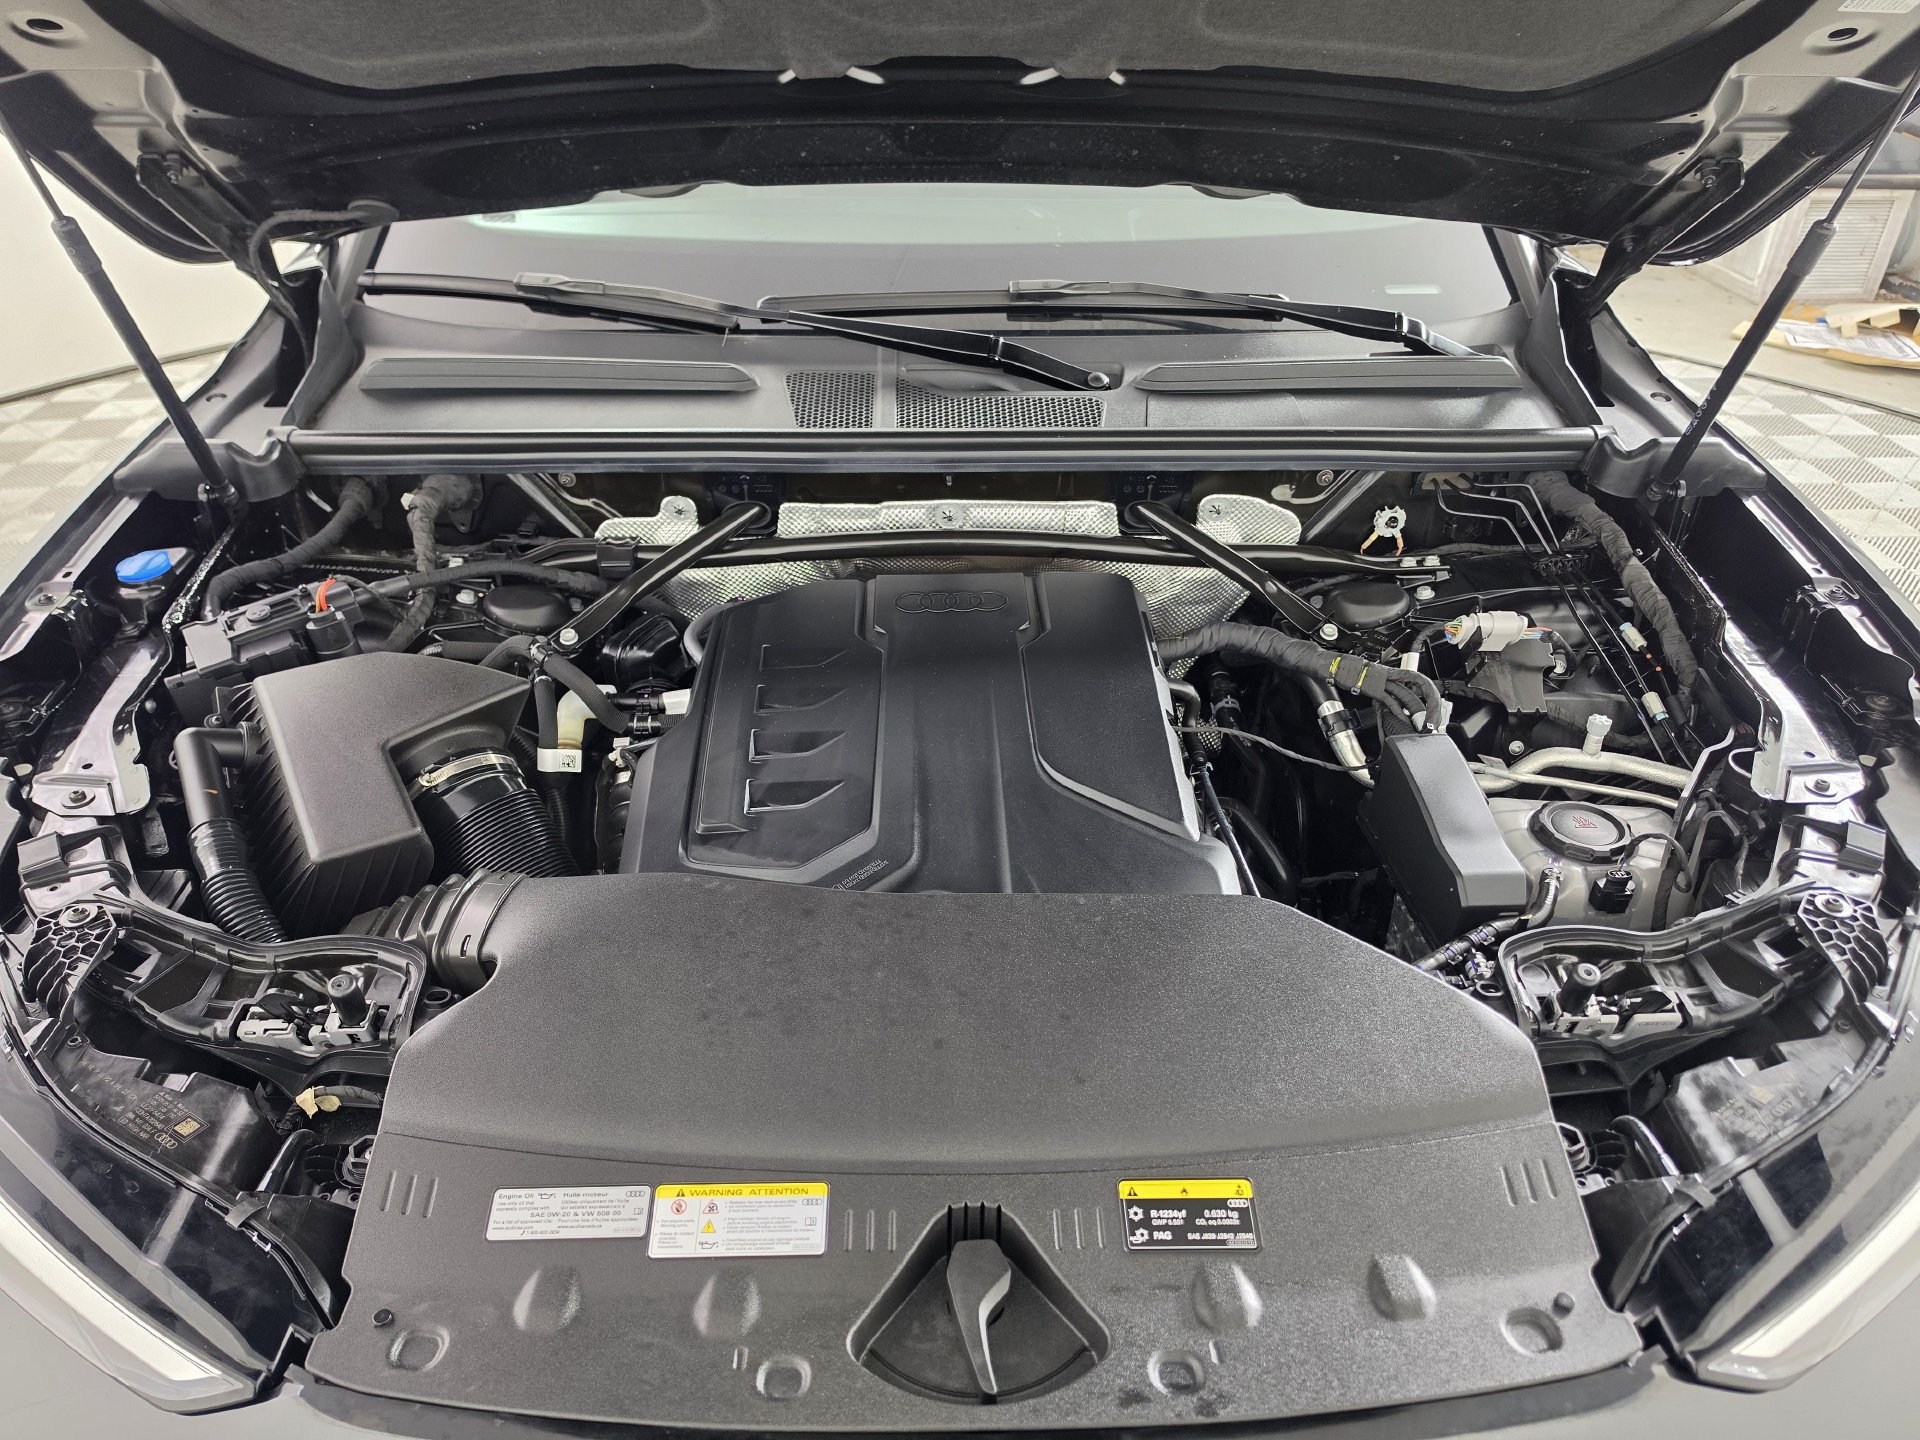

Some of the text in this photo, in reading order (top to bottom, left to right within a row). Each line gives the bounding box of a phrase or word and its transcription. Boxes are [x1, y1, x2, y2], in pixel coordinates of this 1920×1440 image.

[689, 1187, 809, 1197] WARNING ATTENTION
[1150, 1209, 1187, 1219] R-1234yf
[1203, 1209, 1240, 1219] 0.630 kg
[1153, 1230, 1173, 1240] PAG
